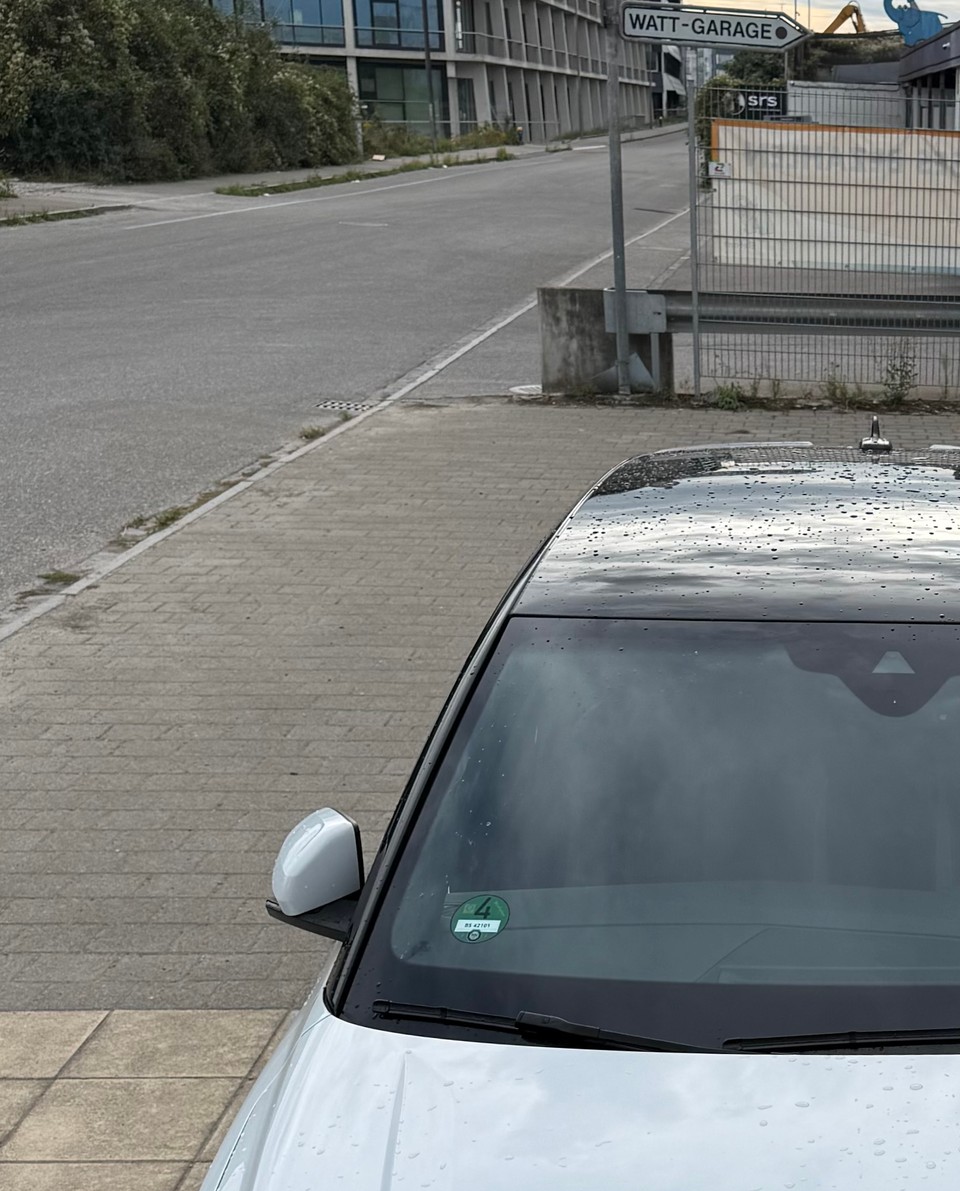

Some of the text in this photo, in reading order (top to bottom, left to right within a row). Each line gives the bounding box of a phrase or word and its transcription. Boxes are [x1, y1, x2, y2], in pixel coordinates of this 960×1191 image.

[629, 13, 772, 39] WATT-GARAGE
[748, 95, 778, 107] srs
[474, 897, 491, 919] 4
